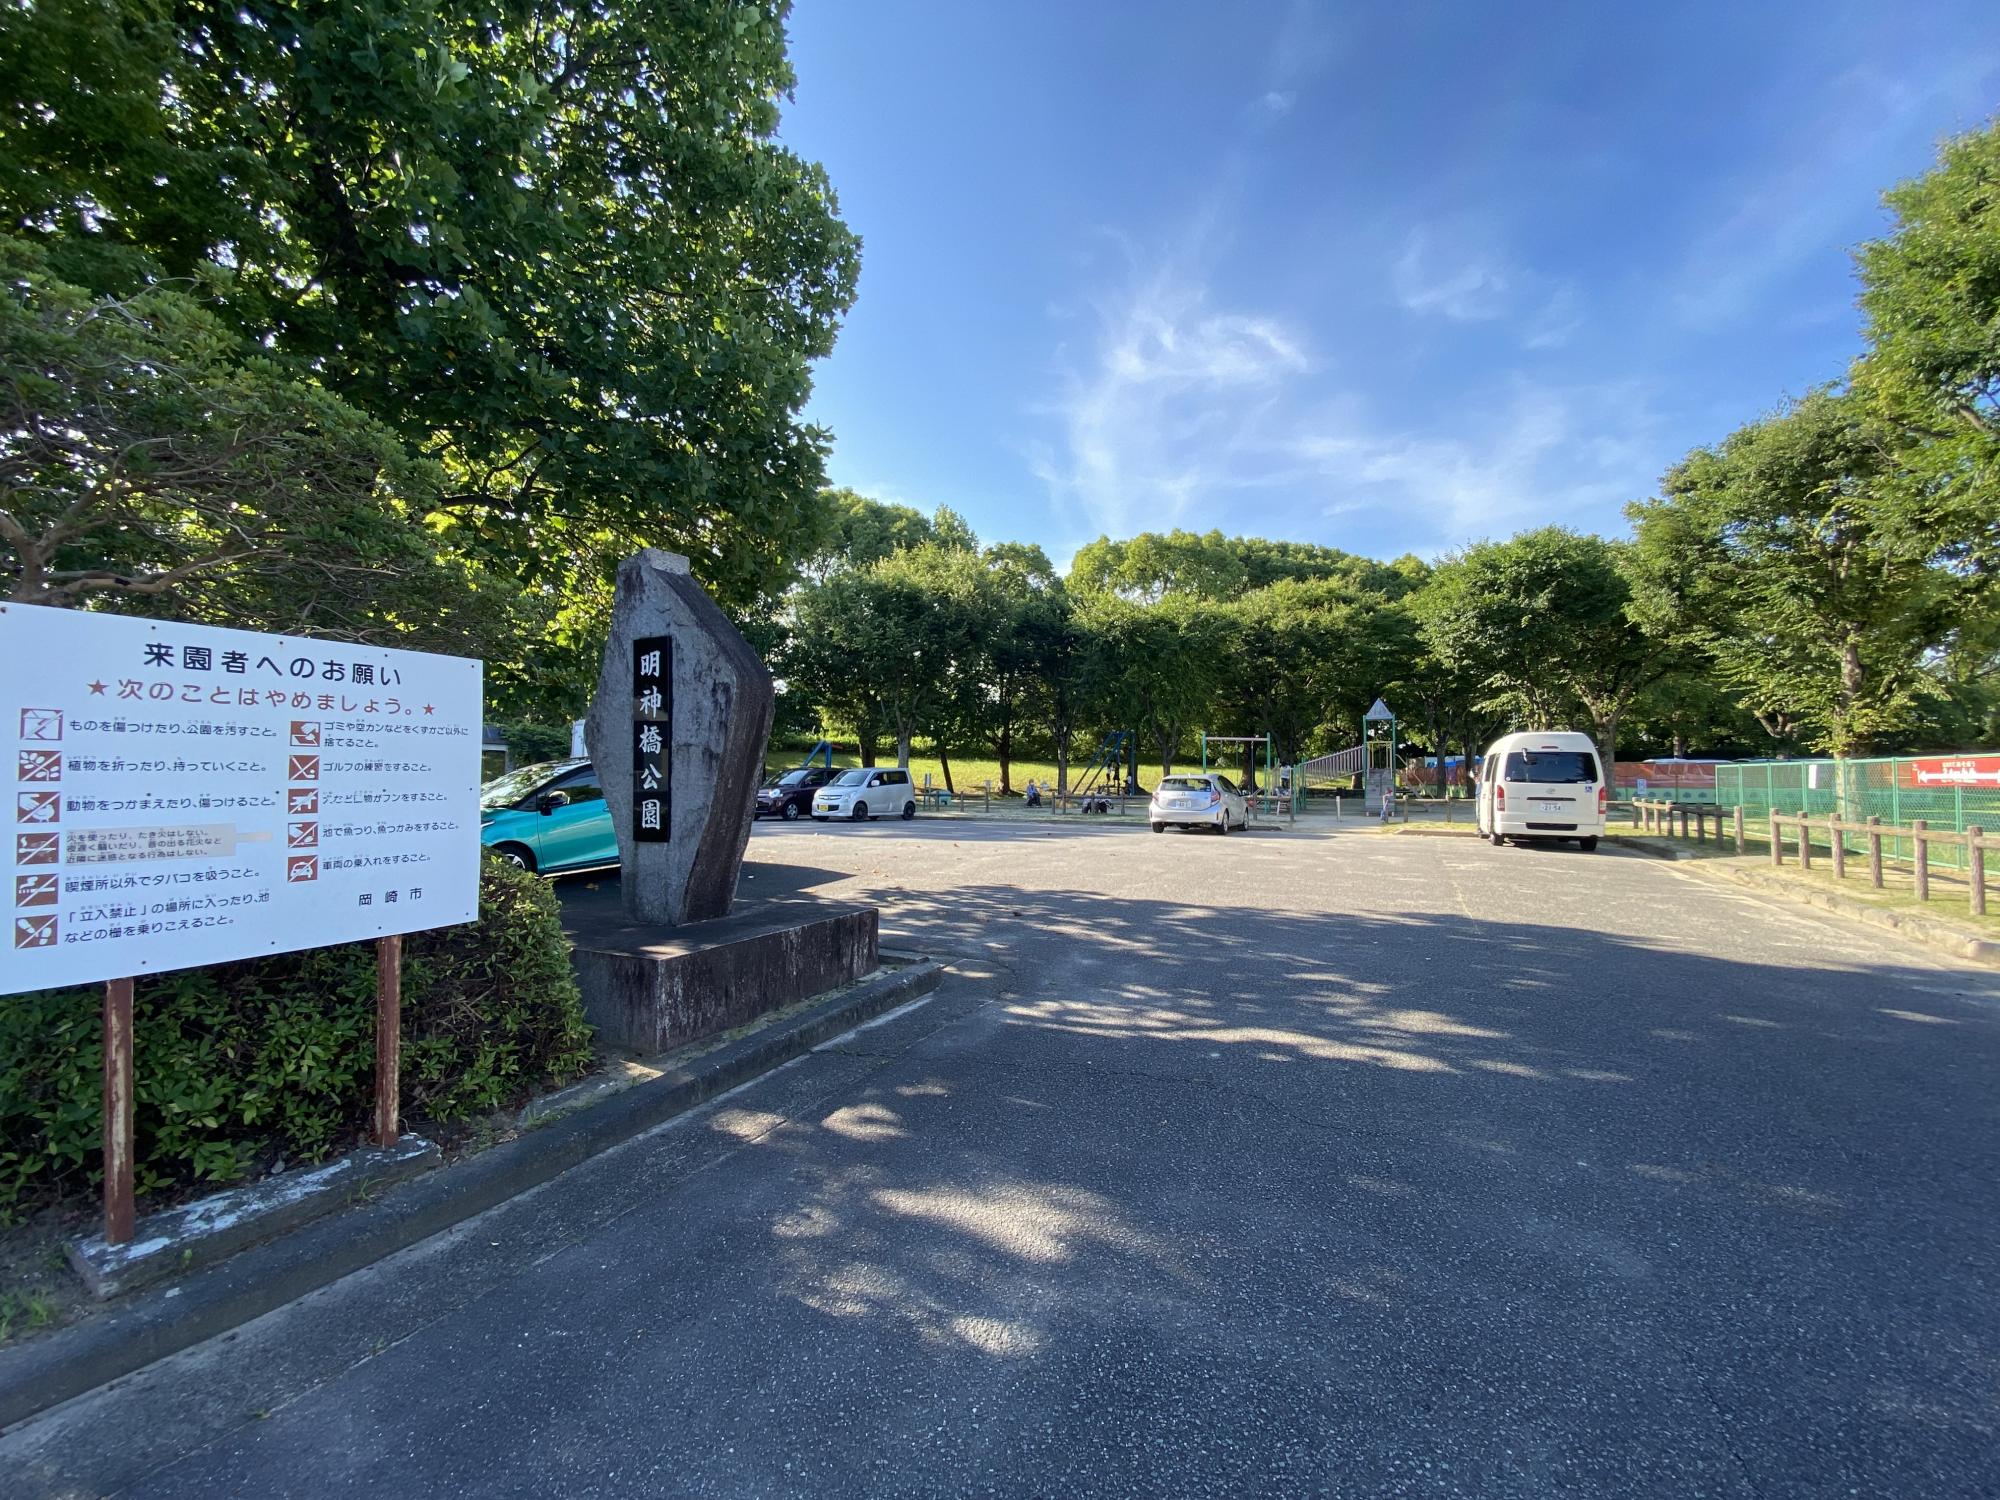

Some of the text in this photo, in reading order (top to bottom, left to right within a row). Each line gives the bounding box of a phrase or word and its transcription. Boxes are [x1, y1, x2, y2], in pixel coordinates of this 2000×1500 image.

[143, 641, 402, 686] 来園者へのお願い
[117, 677, 413, 716] 次のことはやめましょう。
[324, 738, 379, 748] 捨てること。
[638, 650, 663, 831] 明神橋公園
[68, 760, 267, 772] 植物を折ったり、持っていくこと。
[323, 762, 432, 772] ゴルフの練習をすること。
[66, 797, 276, 812] 動物をつかまえたり、傷つけること。
[322, 821, 459, 838] 池で魚つり、魚つかみをすること。
[65, 868, 260, 892] 喫煙所以外でタバコを吸うこと。
